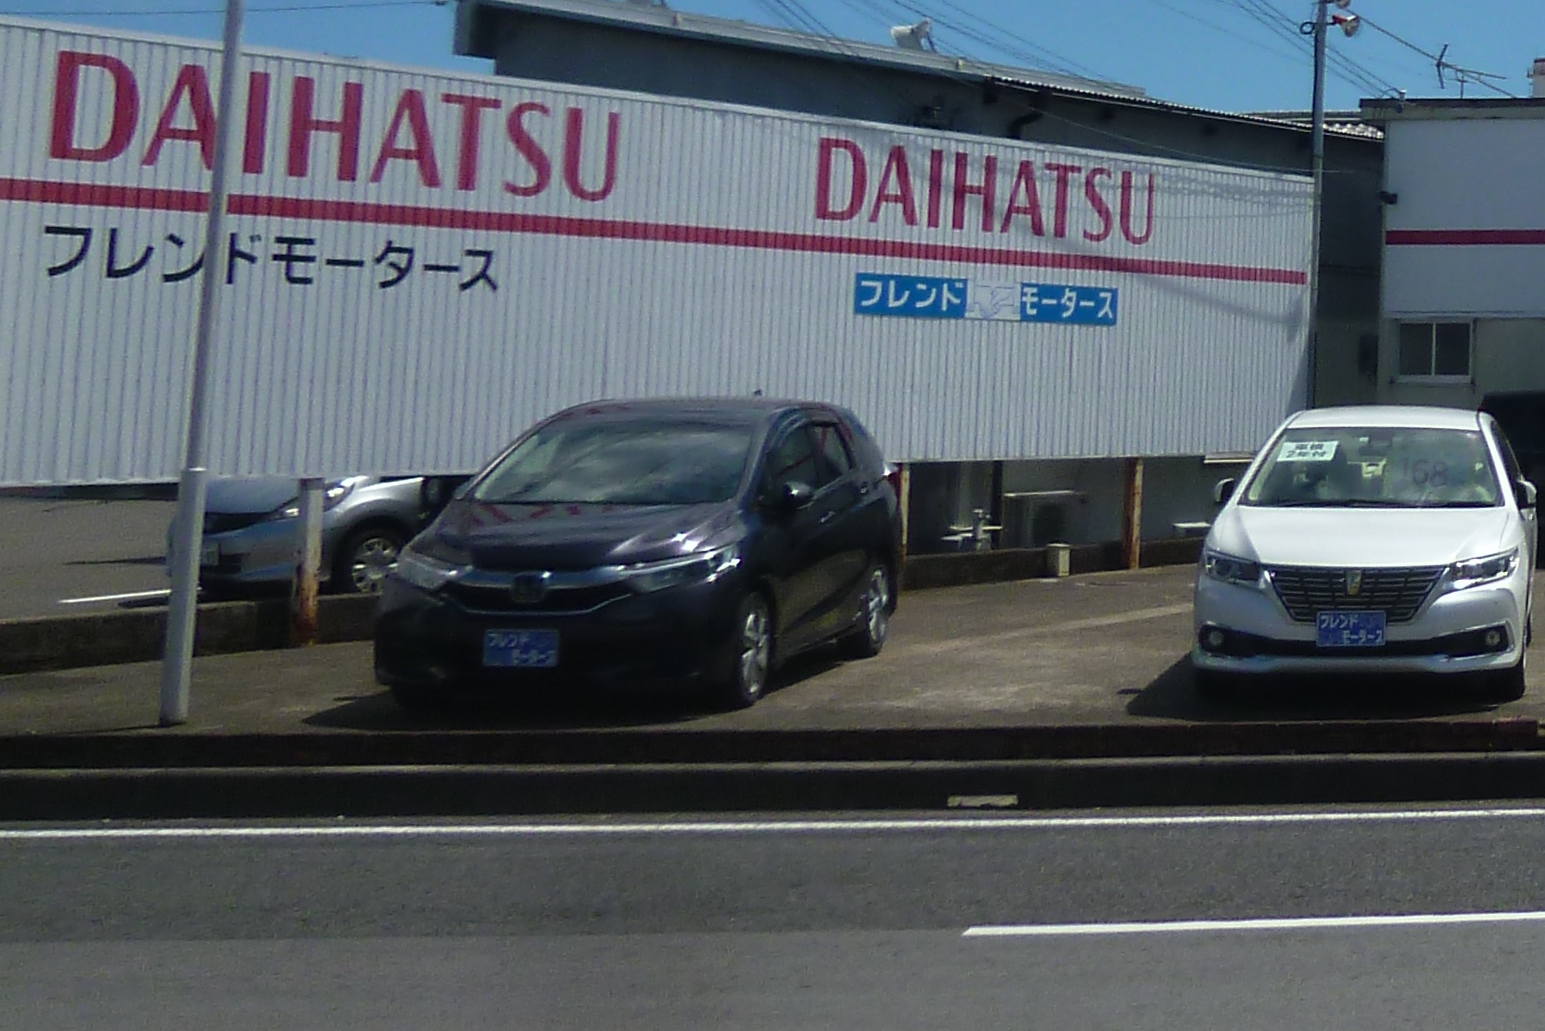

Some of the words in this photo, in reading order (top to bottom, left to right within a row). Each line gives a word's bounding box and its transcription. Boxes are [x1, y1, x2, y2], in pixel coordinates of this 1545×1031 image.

[49, 50, 621, 202] DAIHATSU
[815, 136, 1155, 246] DAIHATSU
[43, 225, 498, 292] フレンドモータース
[860, 280, 964, 311] フレンド
[1021, 285, 1114, 319] モータース
[1320, 614, 1359, 629] フレンド
